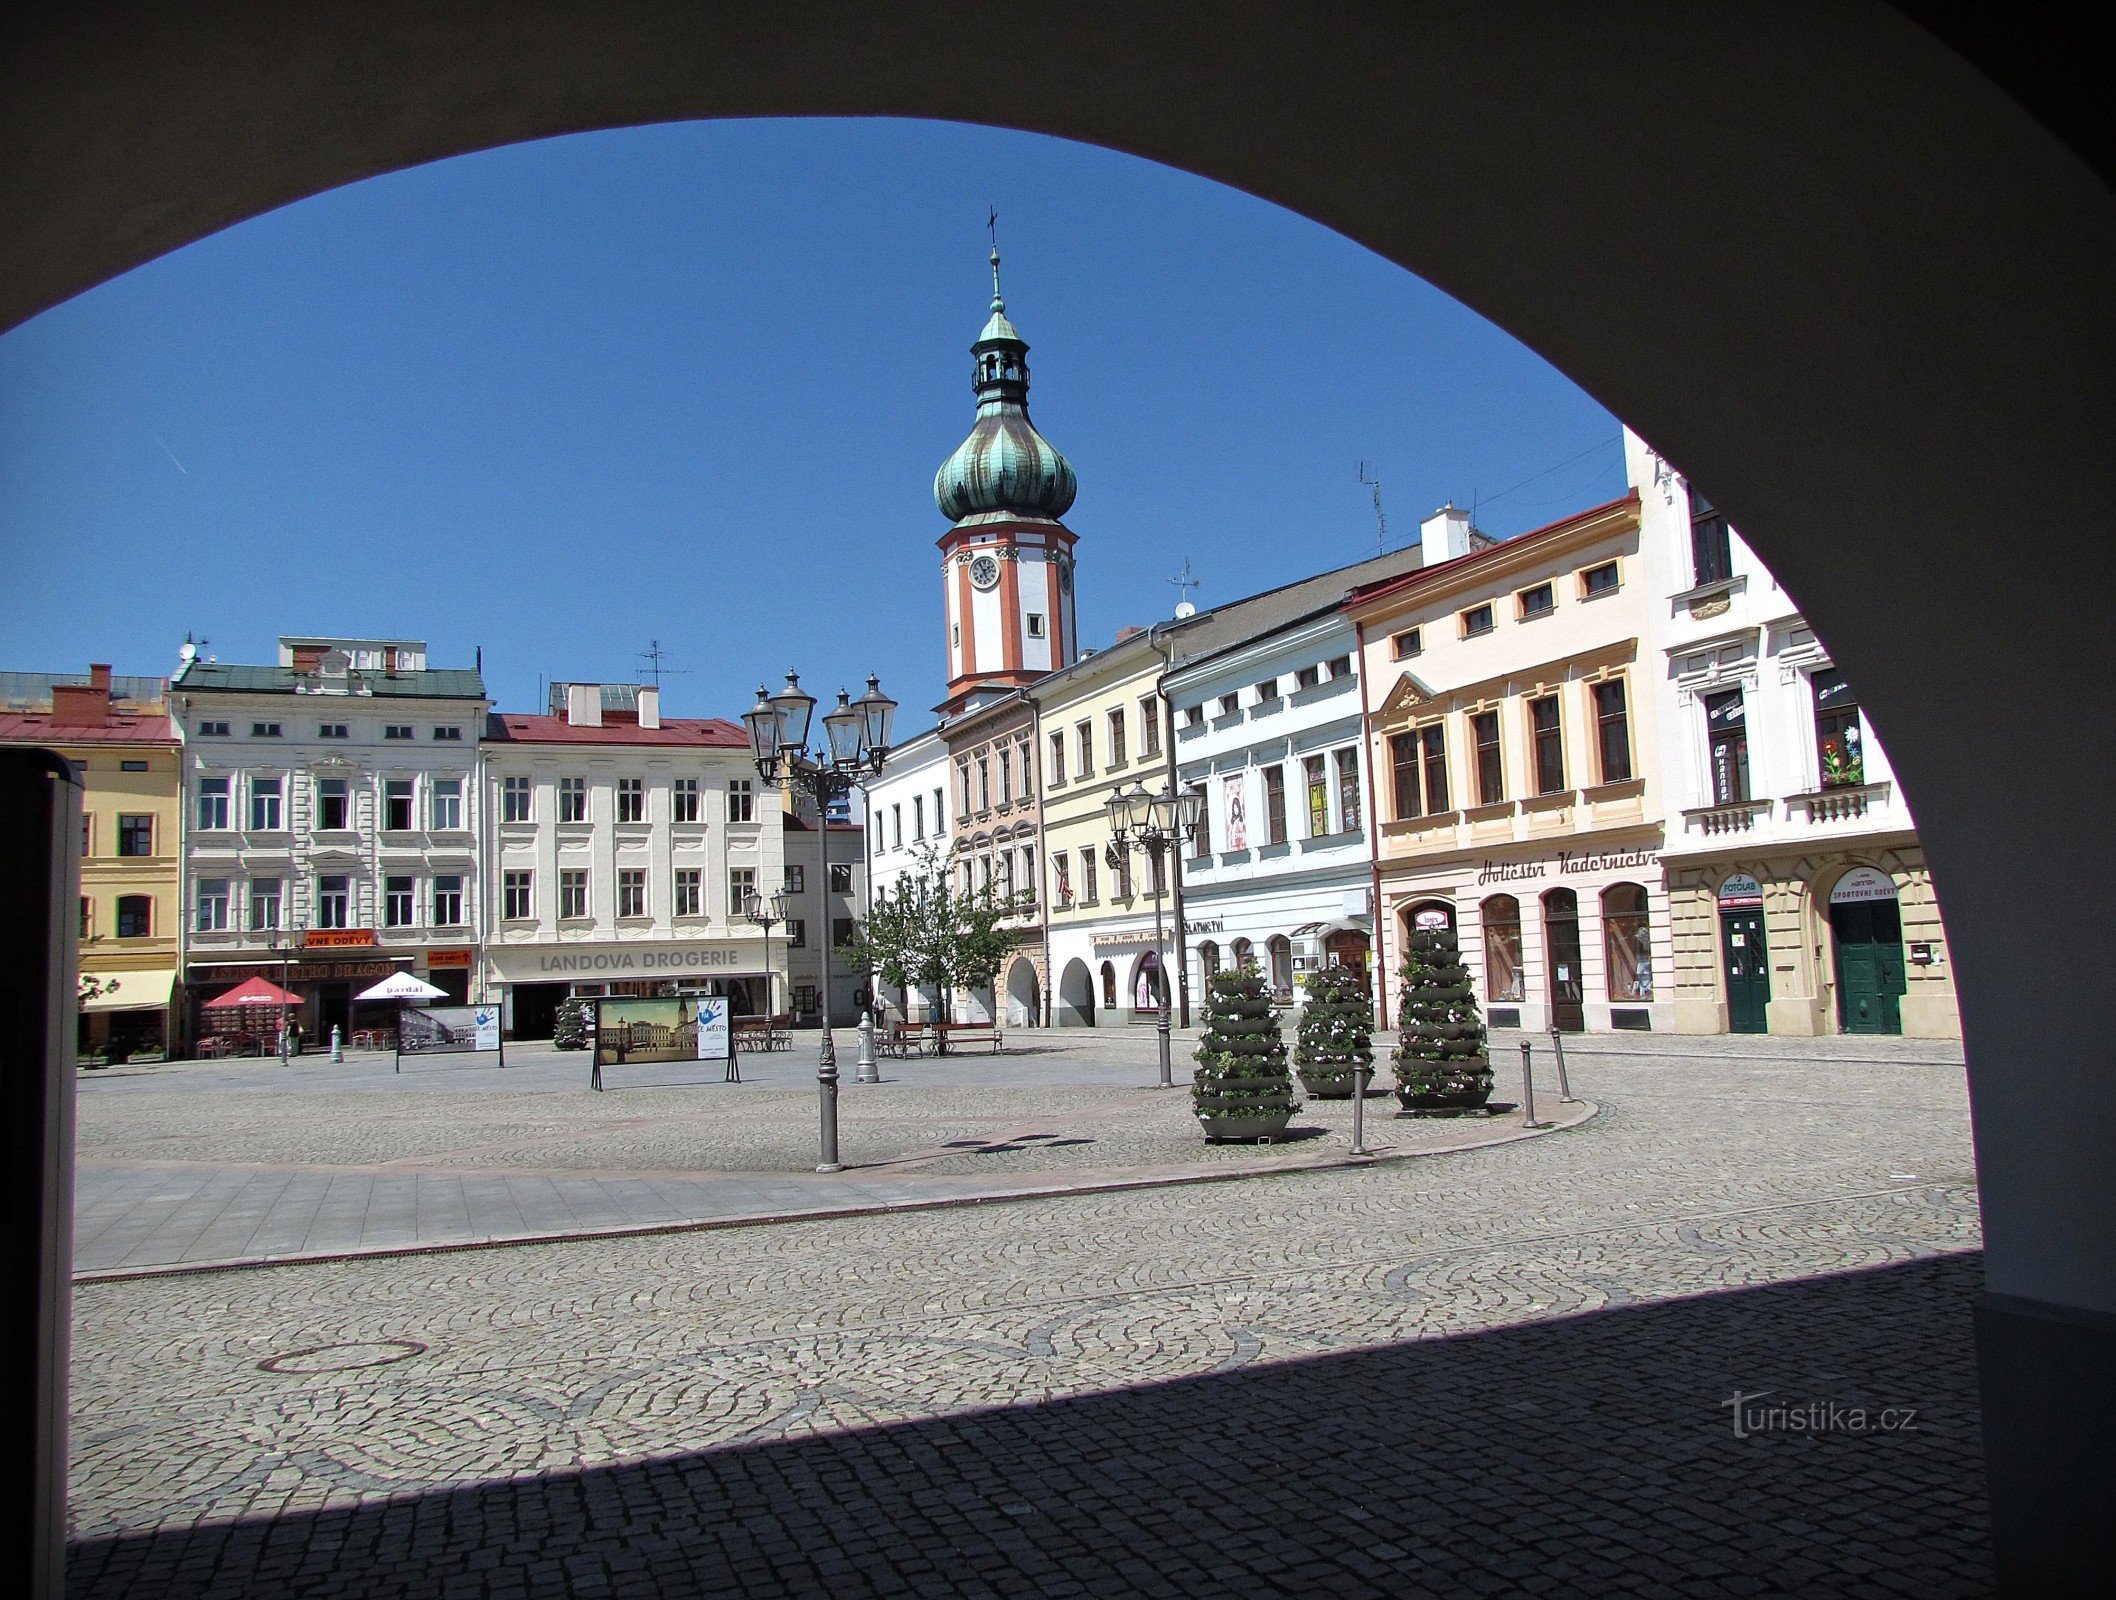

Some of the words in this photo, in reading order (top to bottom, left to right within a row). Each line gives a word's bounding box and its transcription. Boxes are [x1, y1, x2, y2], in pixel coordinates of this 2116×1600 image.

[1478, 858, 1546, 886] Holičství
[1557, 846, 1658, 875] Kadeřnictví
[1724, 882, 1756, 892] FOTOLAB
[333, 936, 371, 945] ODĚVY
[541, 954, 634, 971] LANDOVA
[643, 950, 738, 968] DROGERIE
